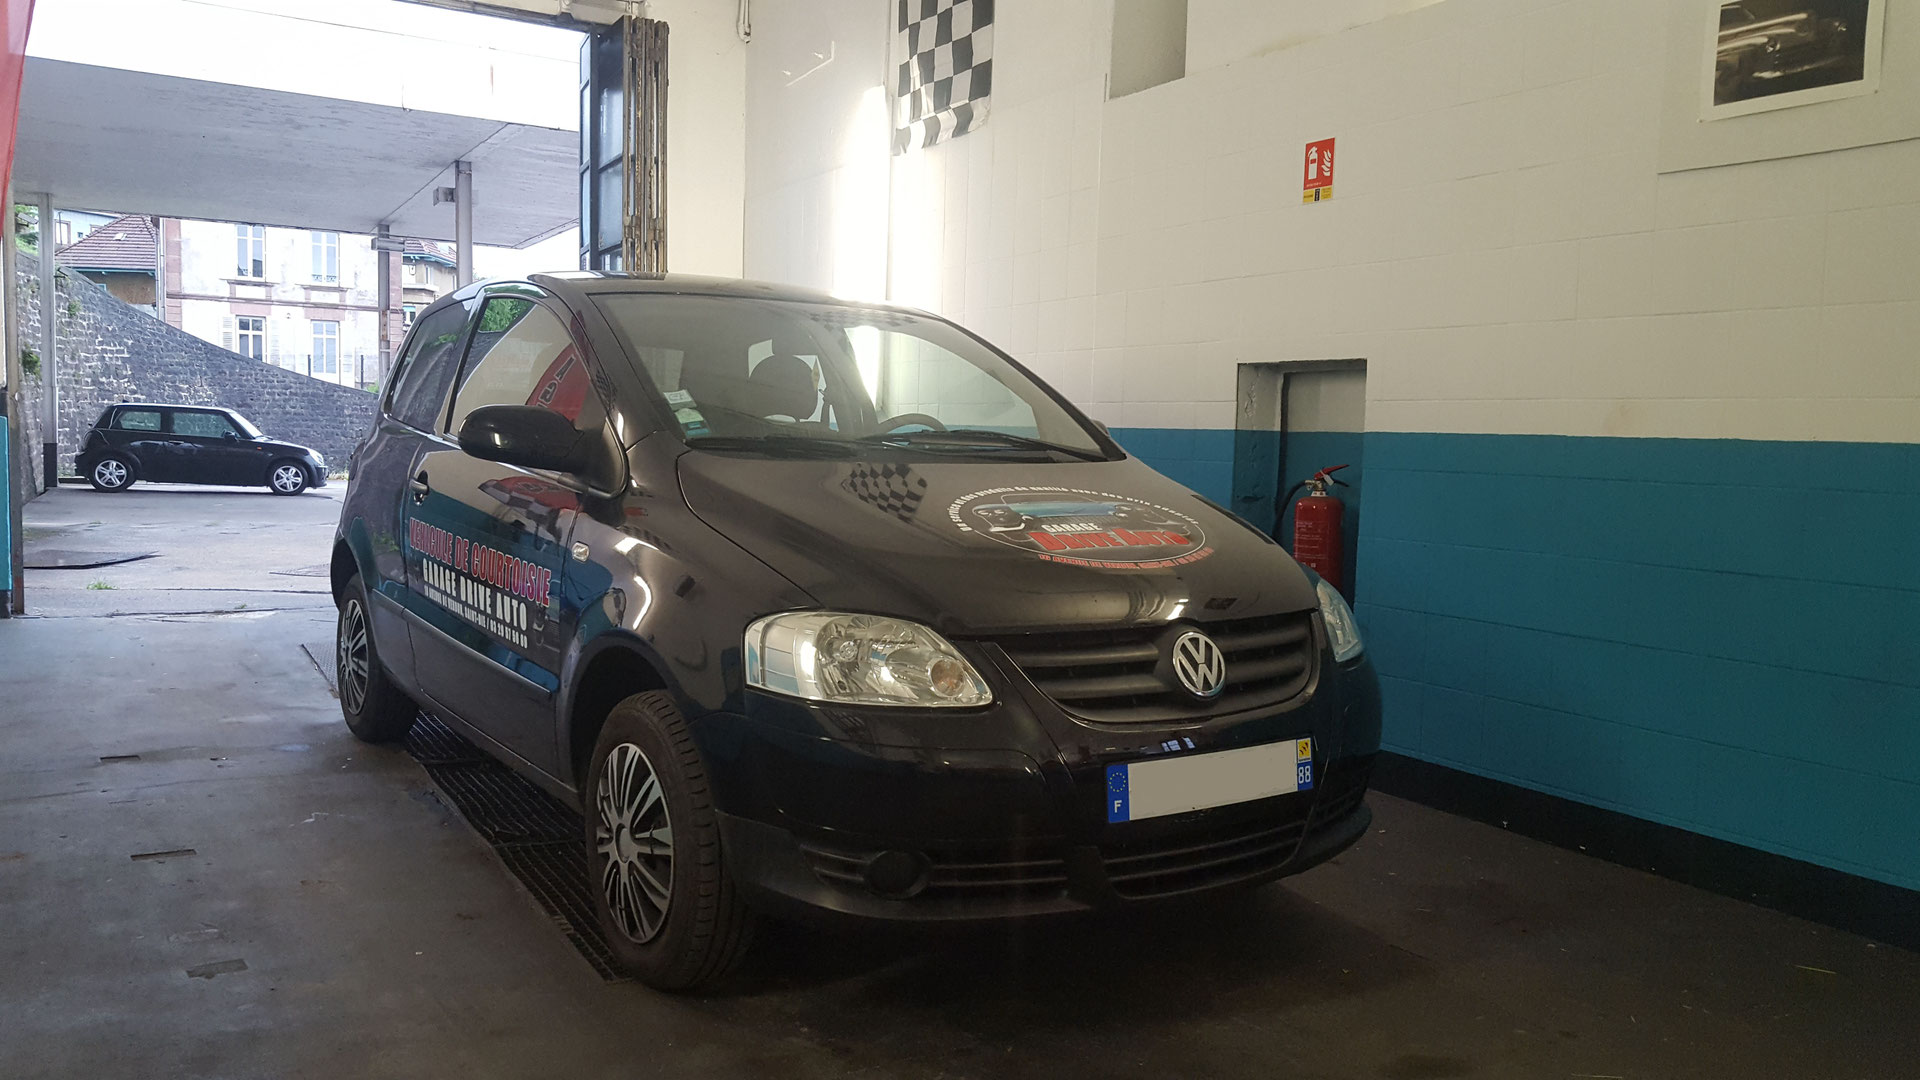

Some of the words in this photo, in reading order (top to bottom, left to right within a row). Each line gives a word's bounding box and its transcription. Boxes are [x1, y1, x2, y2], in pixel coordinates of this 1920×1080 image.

[1041, 522, 1103, 533] GARAGE
[1027, 532, 1124, 551] DRIVE
[454, 535, 469, 573] DE
[471, 542, 552, 607] COURTOISIE
[423, 557, 457, 598] GARAGE
[460, 575, 492, 615] DRIVE
[496, 592, 527, 631] AUTO
[1298, 765, 1312, 785] 88
[1113, 799, 1123, 814] F
